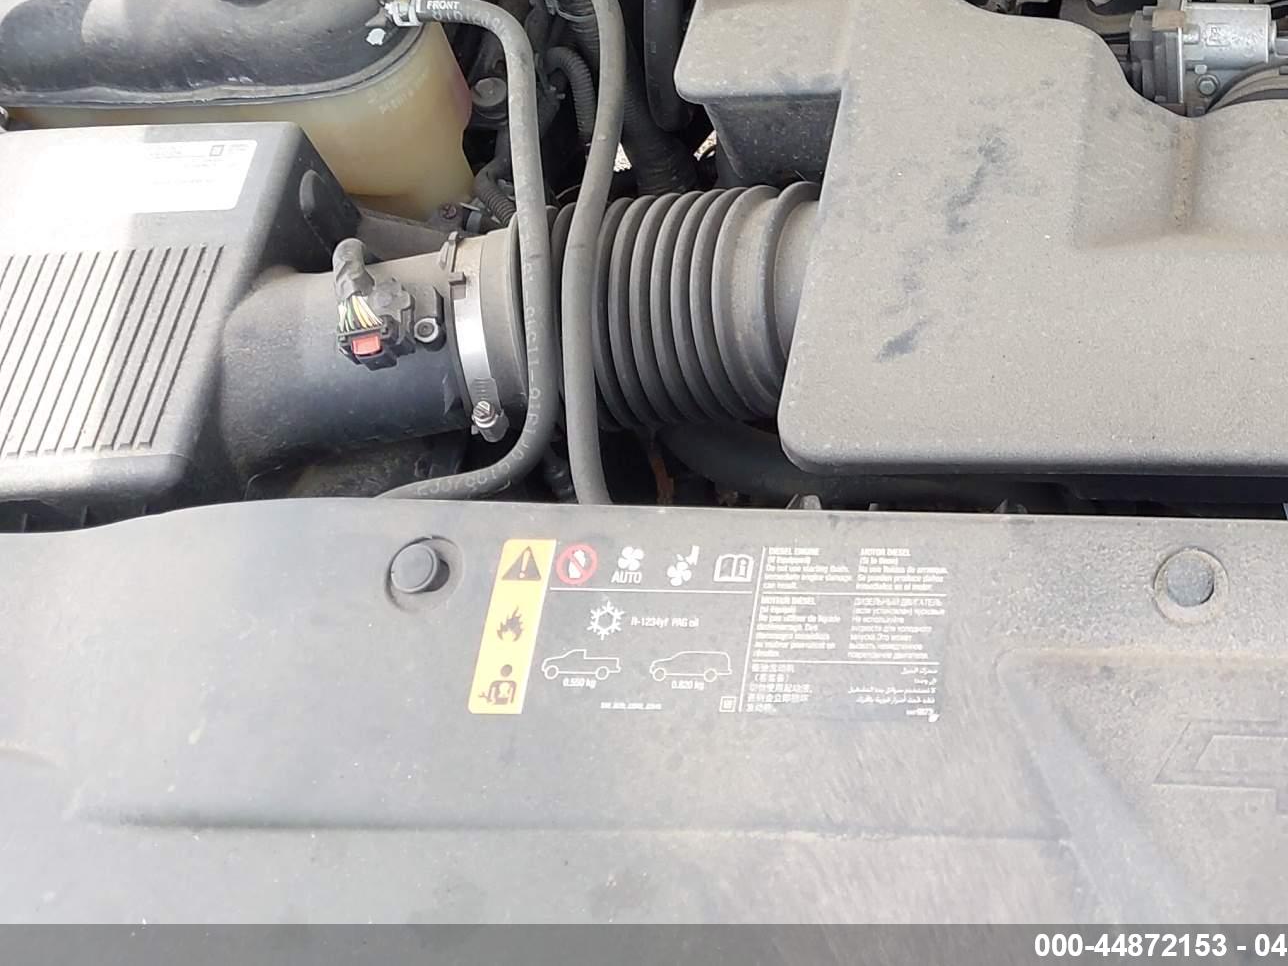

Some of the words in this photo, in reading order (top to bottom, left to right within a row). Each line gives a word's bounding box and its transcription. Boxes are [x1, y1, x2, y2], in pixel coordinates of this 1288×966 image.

[426, 0, 460, 10] FRONT
[860, 547, 886, 556] MOTOR
[611, 571, 643, 584] AUTO
